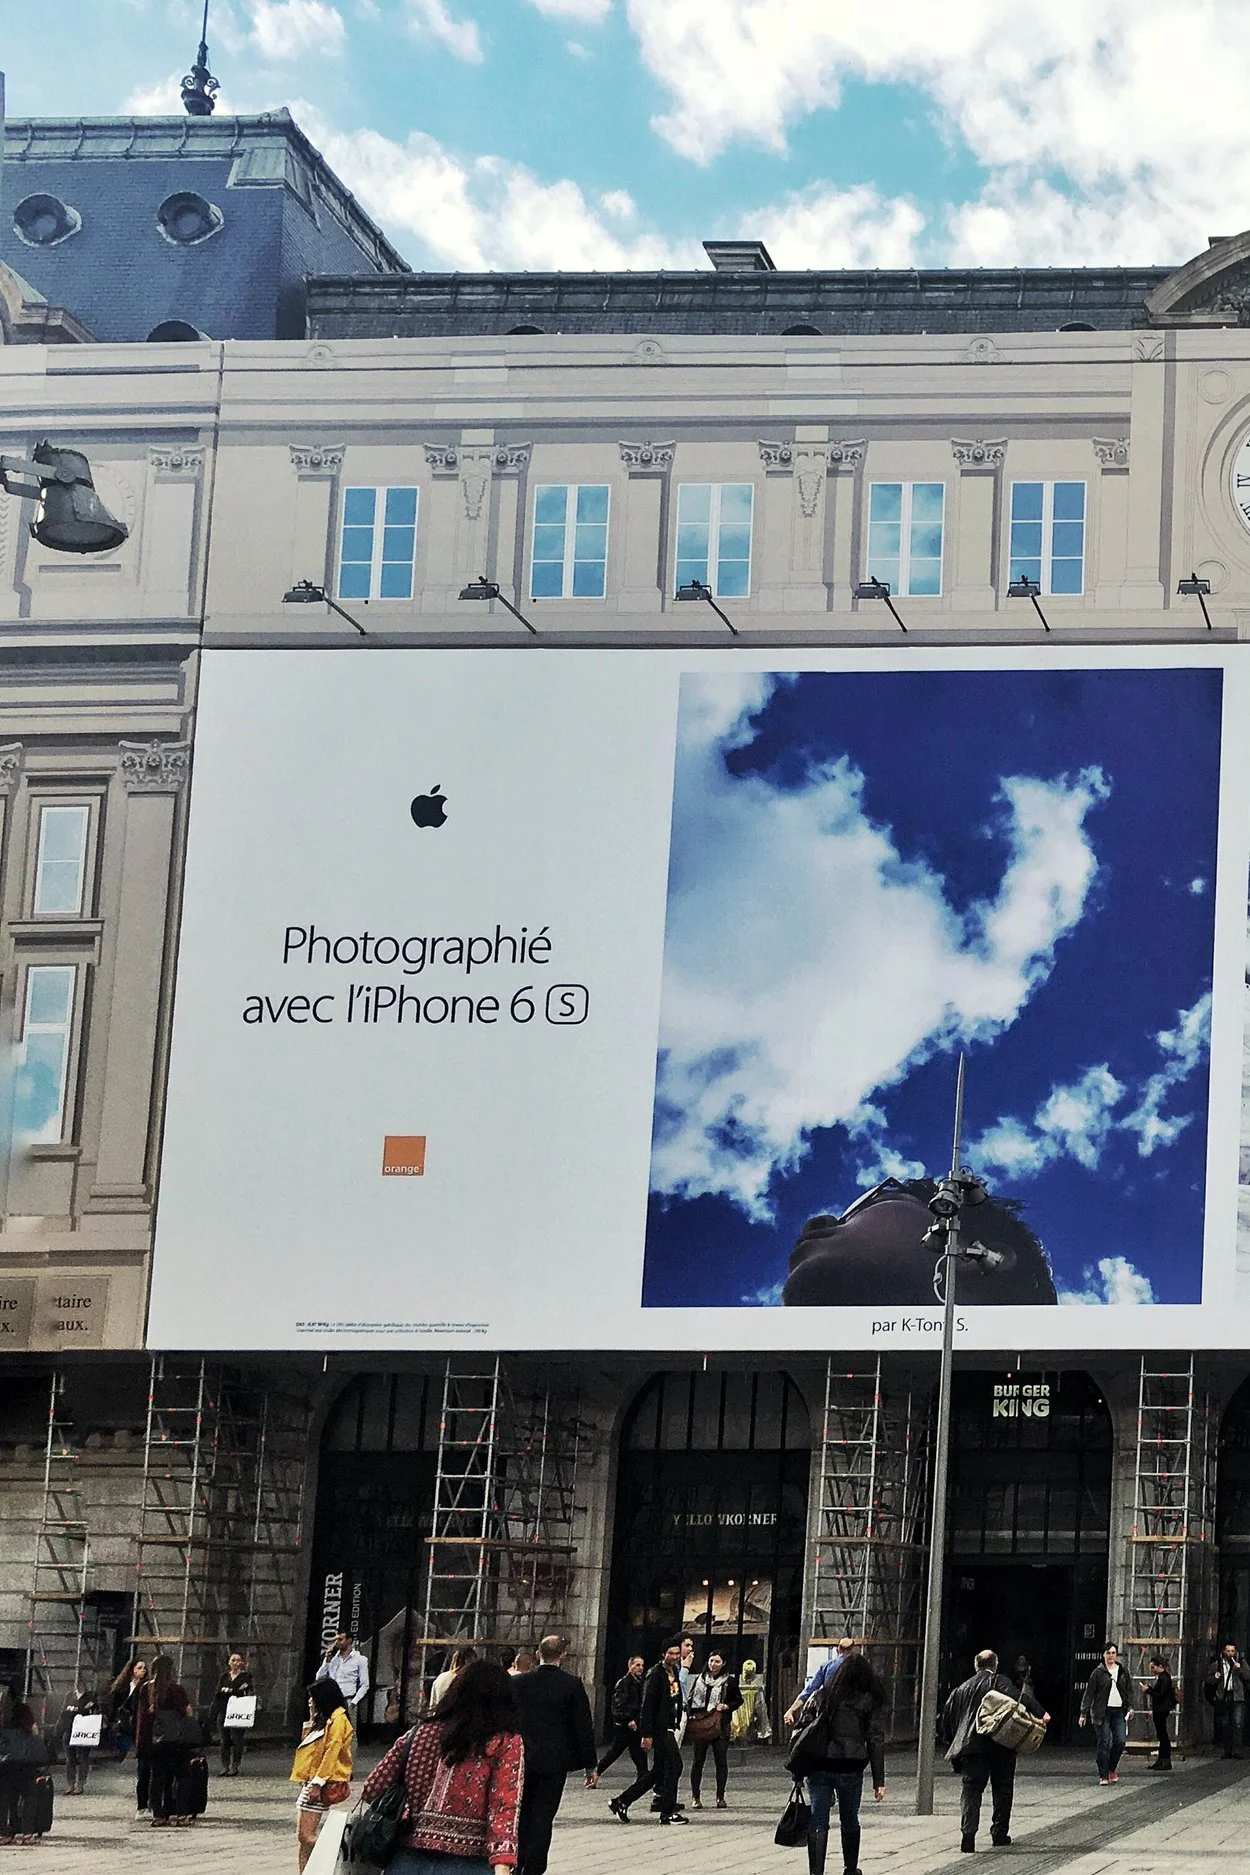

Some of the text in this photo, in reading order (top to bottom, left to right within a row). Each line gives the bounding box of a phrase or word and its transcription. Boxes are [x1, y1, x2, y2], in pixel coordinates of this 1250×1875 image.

[282, 924, 552, 975] Photographié
[242, 995, 335, 1025] avec
[347, 984, 500, 1025] l'iPhone
[384, 1165, 420, 1175] orange
[872, 1317, 969, 1335] par K-Ton S.
[993, 1384, 1050, 1397] BURGER
[993, 1398, 1050, 1418] KING
[673, 1513, 777, 1526] YLLOWKORNER
[352, 1583, 362, 1619] EDITION
